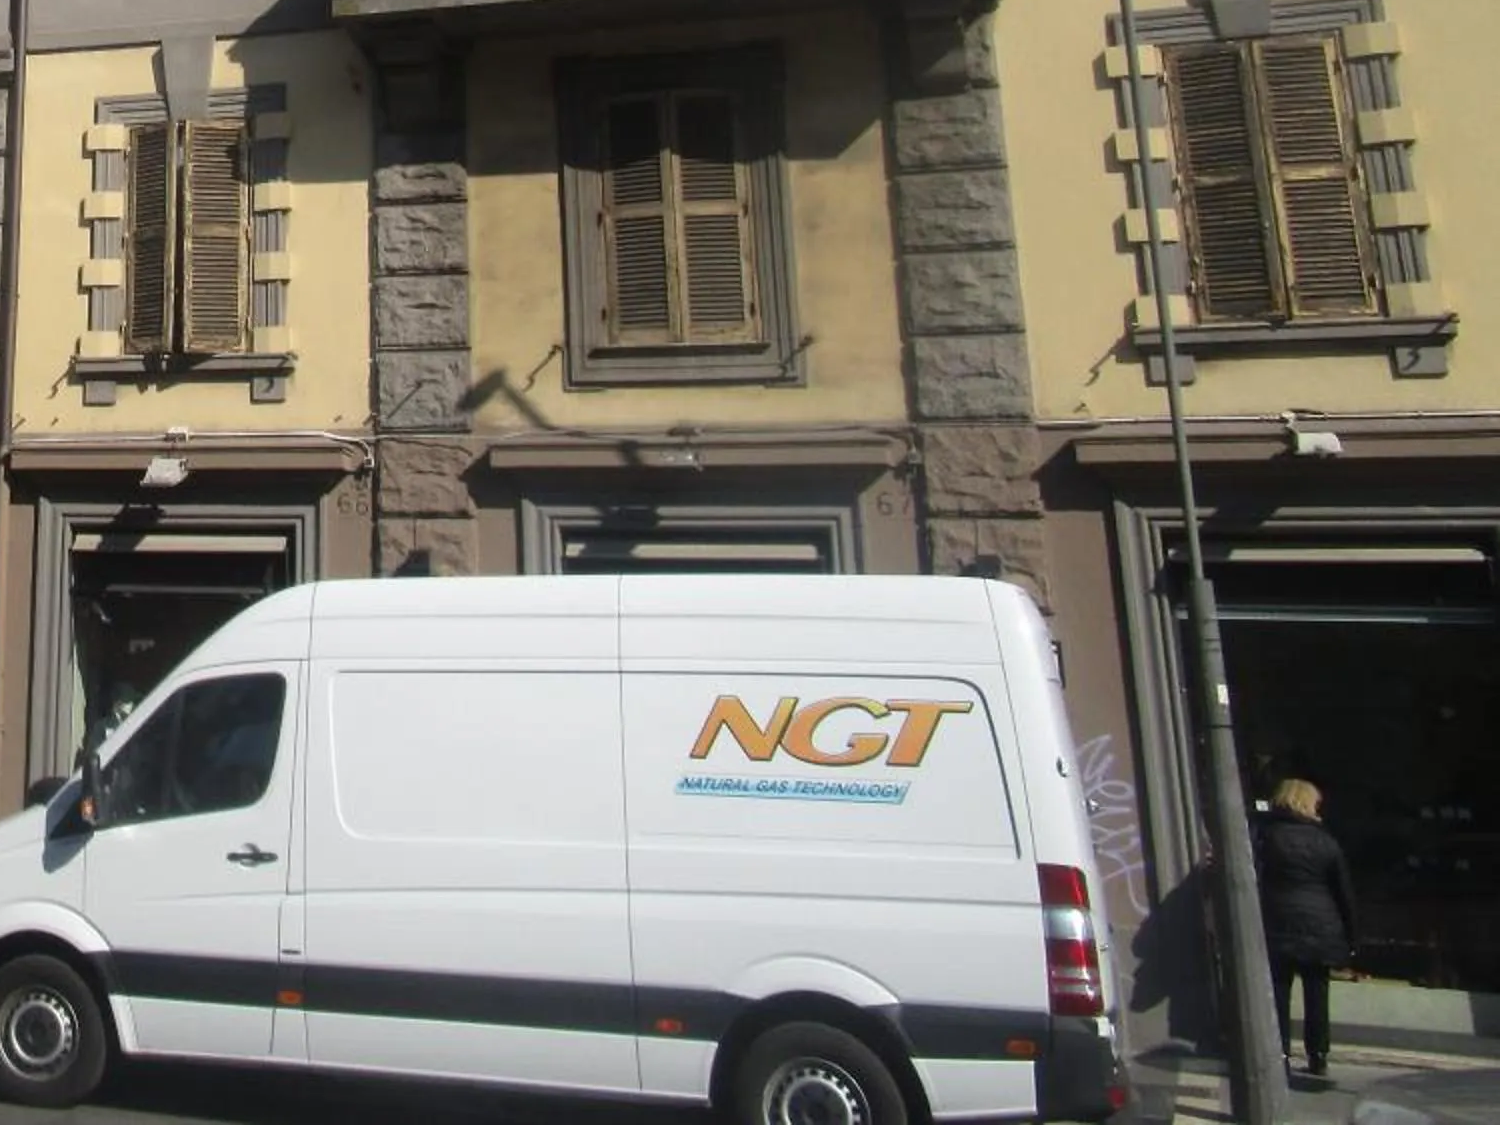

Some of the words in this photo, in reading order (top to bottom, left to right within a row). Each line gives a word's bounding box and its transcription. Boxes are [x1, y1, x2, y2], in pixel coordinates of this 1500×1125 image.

[689, 695, 974, 767] NGT
[680, 777, 750, 791] NATURAL
[756, 779, 789, 794] GAS
[793, 780, 902, 798] TECHNOLOGY
